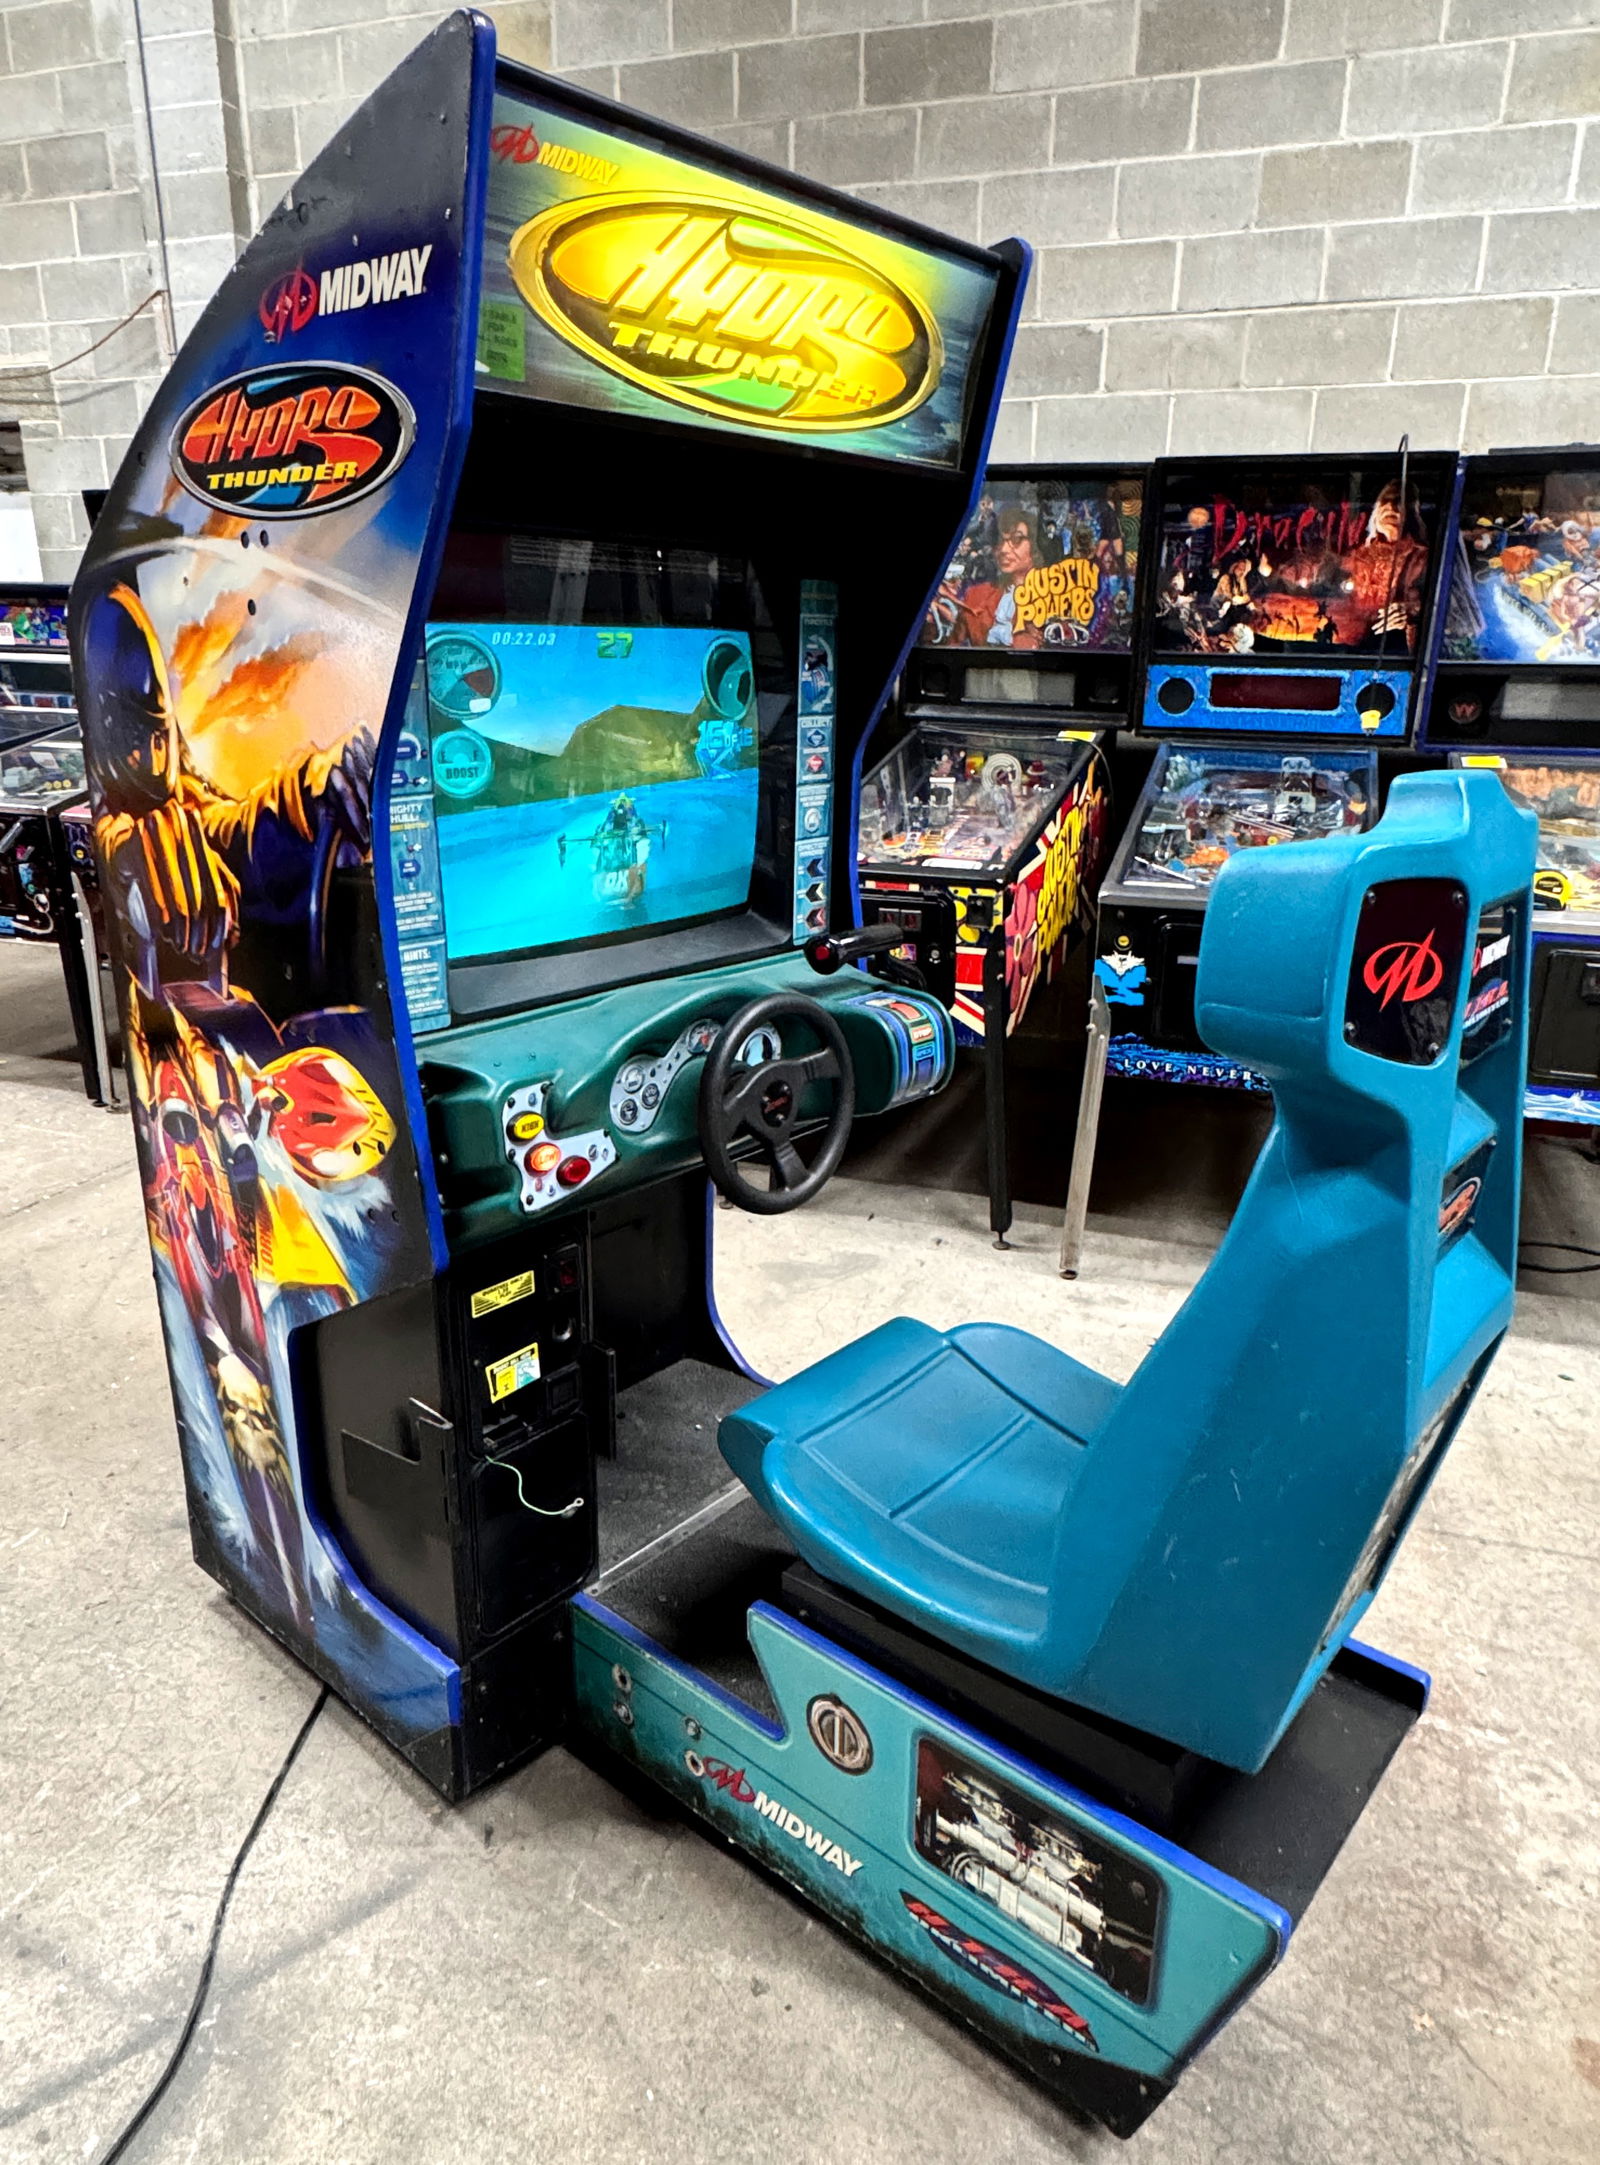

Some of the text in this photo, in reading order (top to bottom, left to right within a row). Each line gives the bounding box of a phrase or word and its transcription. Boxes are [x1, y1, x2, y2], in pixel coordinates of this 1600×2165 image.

[537, 142, 619, 185] MIDWAY
[319, 245, 432, 316] MIDWAY
[608, 321, 878, 409] THUNDER
[182, 385, 383, 465] HYDRO
[206, 460, 359, 490] THUNDER
[1014, 558, 1100, 606] AUSTIN
[1012, 587, 1096, 634] POWERS
[596, 631, 634, 659] 27
[445, 766, 481, 780] BOOST
[1124, 1058, 1252, 1081] LOVE NEVER
[754, 1791, 865, 1878] MIDWAY
